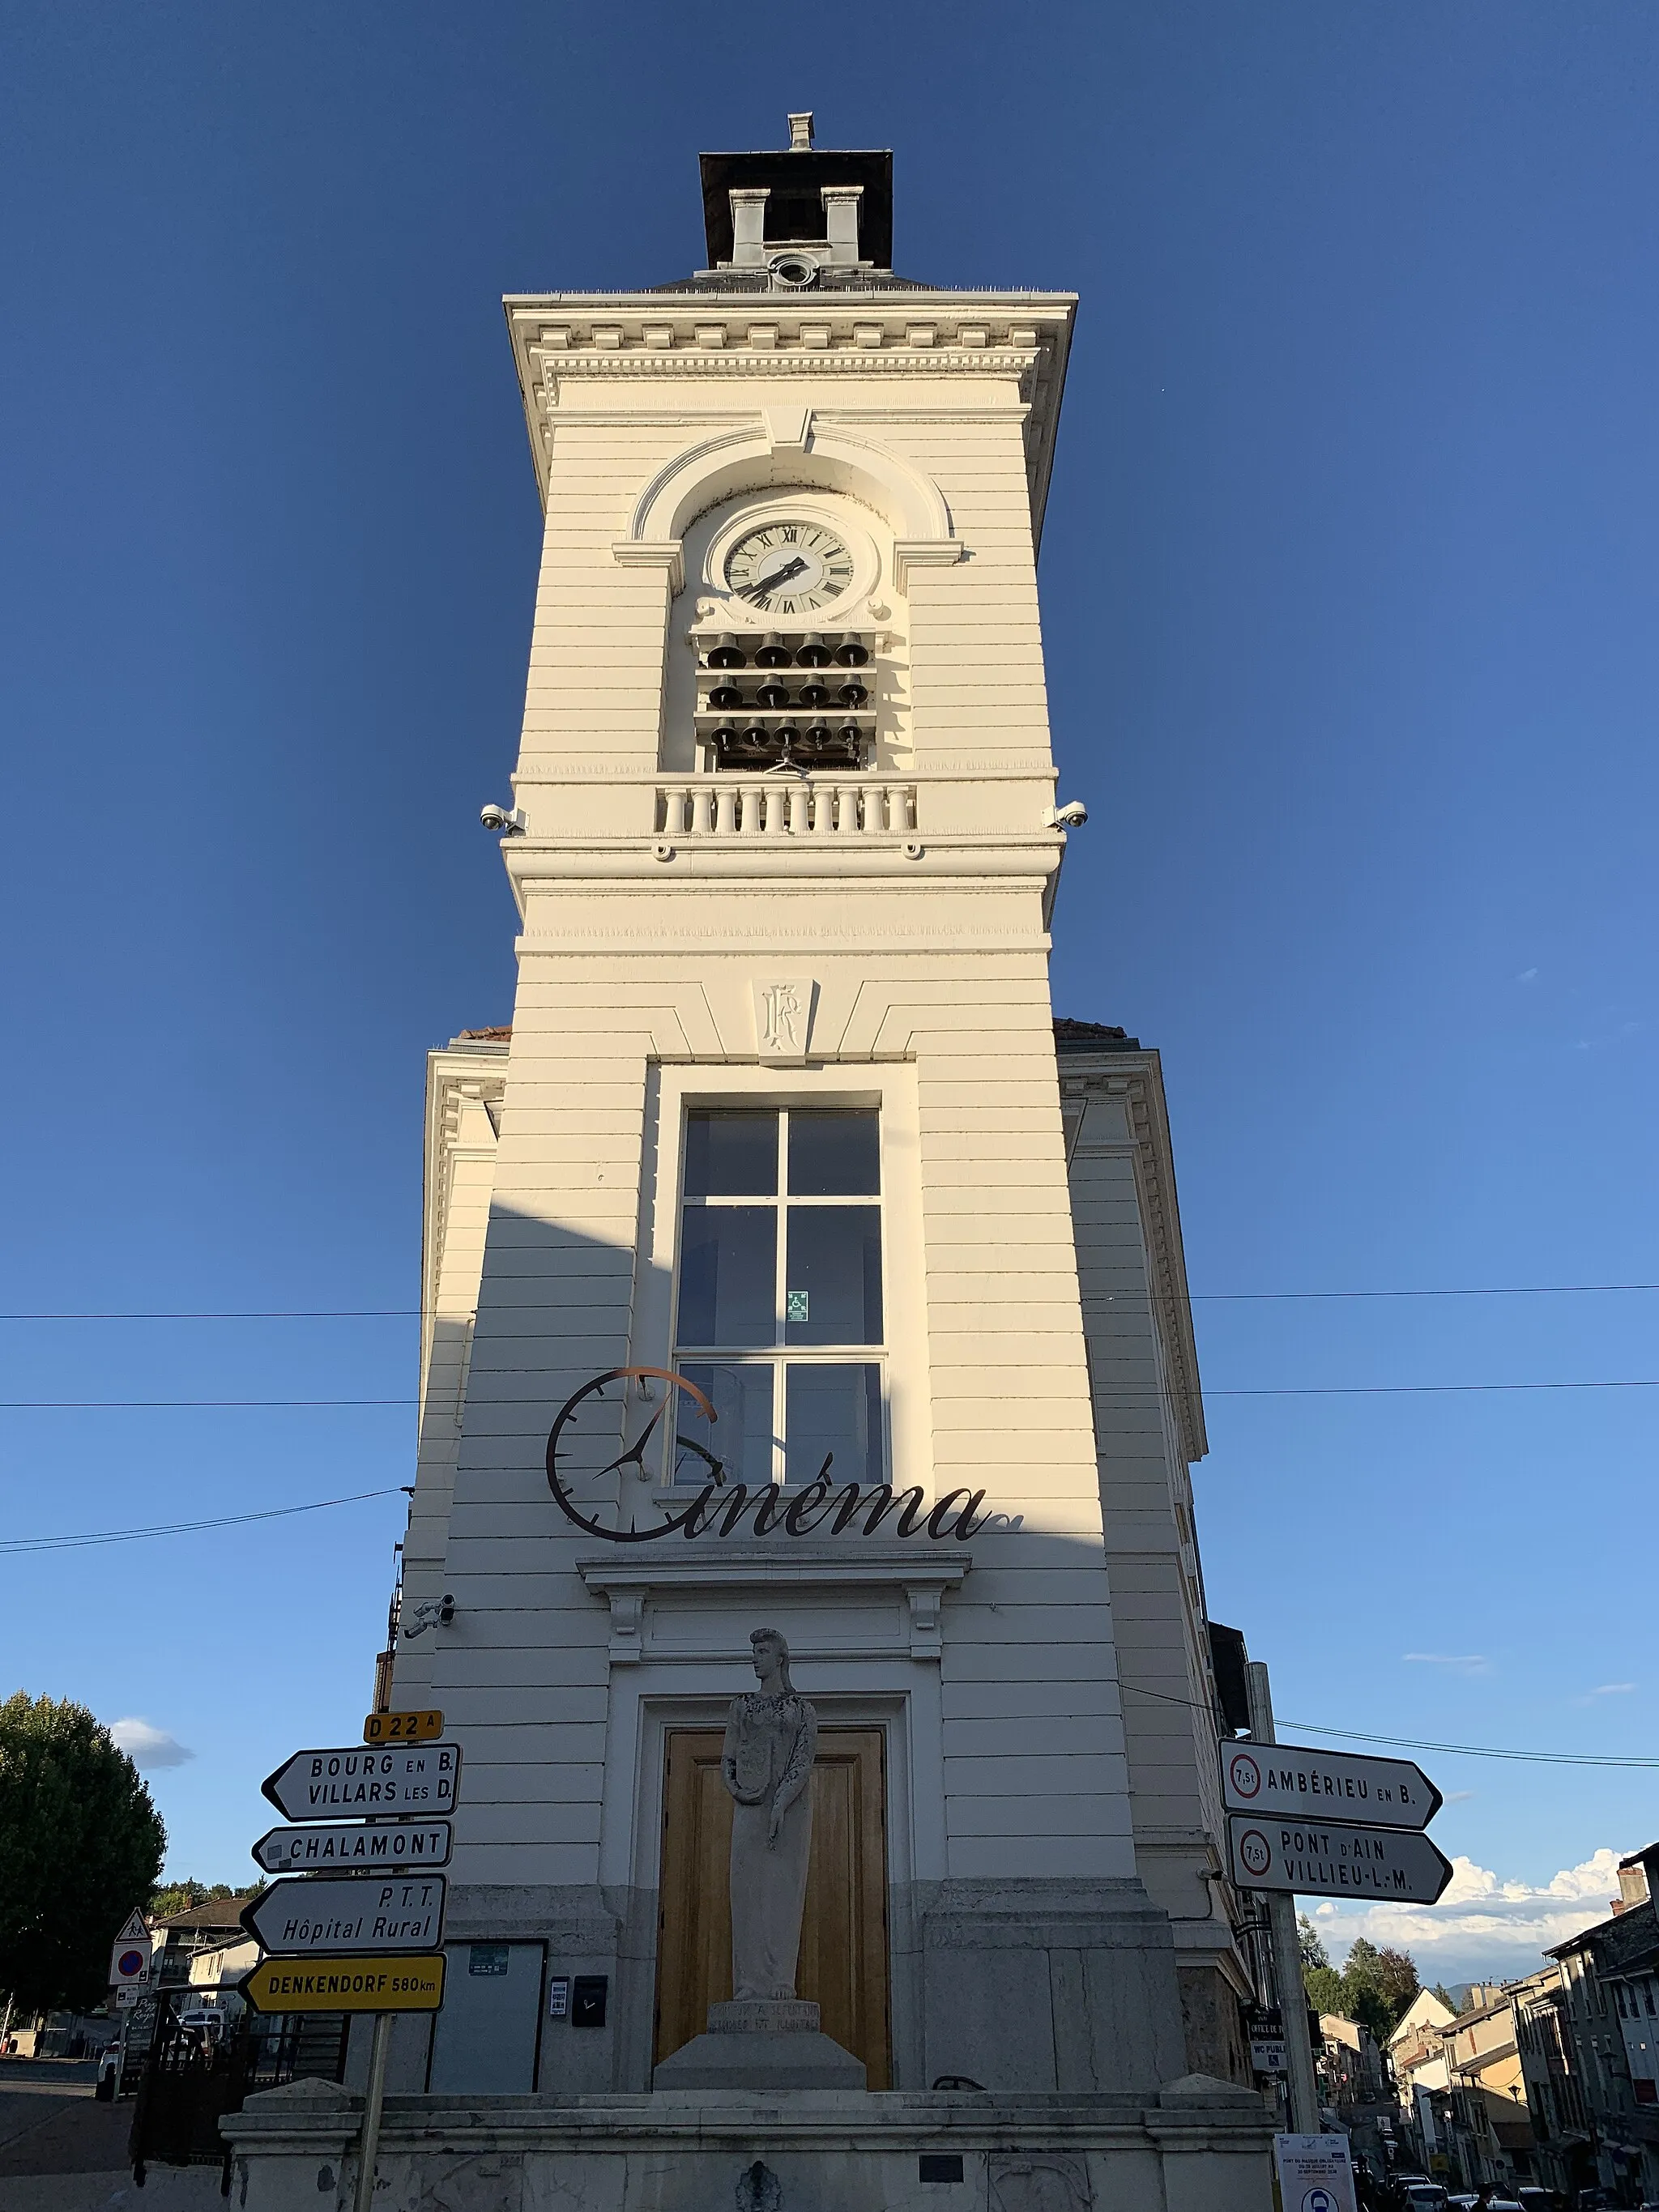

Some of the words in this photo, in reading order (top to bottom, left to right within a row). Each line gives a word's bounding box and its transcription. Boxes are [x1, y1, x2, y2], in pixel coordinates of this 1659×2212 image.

[782, 529, 797, 543] XII
[546, 1366, 992, 1542] Cinéma
[369, 1719, 382, 1738] D
[389, 1715, 418, 1737] 22
[310, 1754, 394, 1778] BOURG
[406, 1760, 425, 1774] EN
[438, 1752, 454, 1772] B.
[1235, 1768, 1255, 1784] 7,5t
[309, 1781, 397, 1805] VILLARS
[404, 1786, 429, 1801] LES
[437, 1779, 452, 1800] D.
[1267, 1769, 1368, 1800] AMBÉRIEU
[1377, 1788, 1392, 1802] EN
[1399, 1784, 1416, 1805] B.
[290, 1832, 441, 1860] CHALAMONT
[1246, 1845, 1265, 1863] 7,5t
[1280, 1831, 1330, 1856] PONT
[1283, 1859, 1414, 1891] VILLIEU-L.-M.
[283, 1917, 364, 1944] Hôpital
[372, 1916, 431, 1939] Rural
[269, 1974, 387, 1995] DENKENDORF
[1254, 2045, 1265, 2053] WC
[1265, 2045, 1286, 2053] PUBLI
